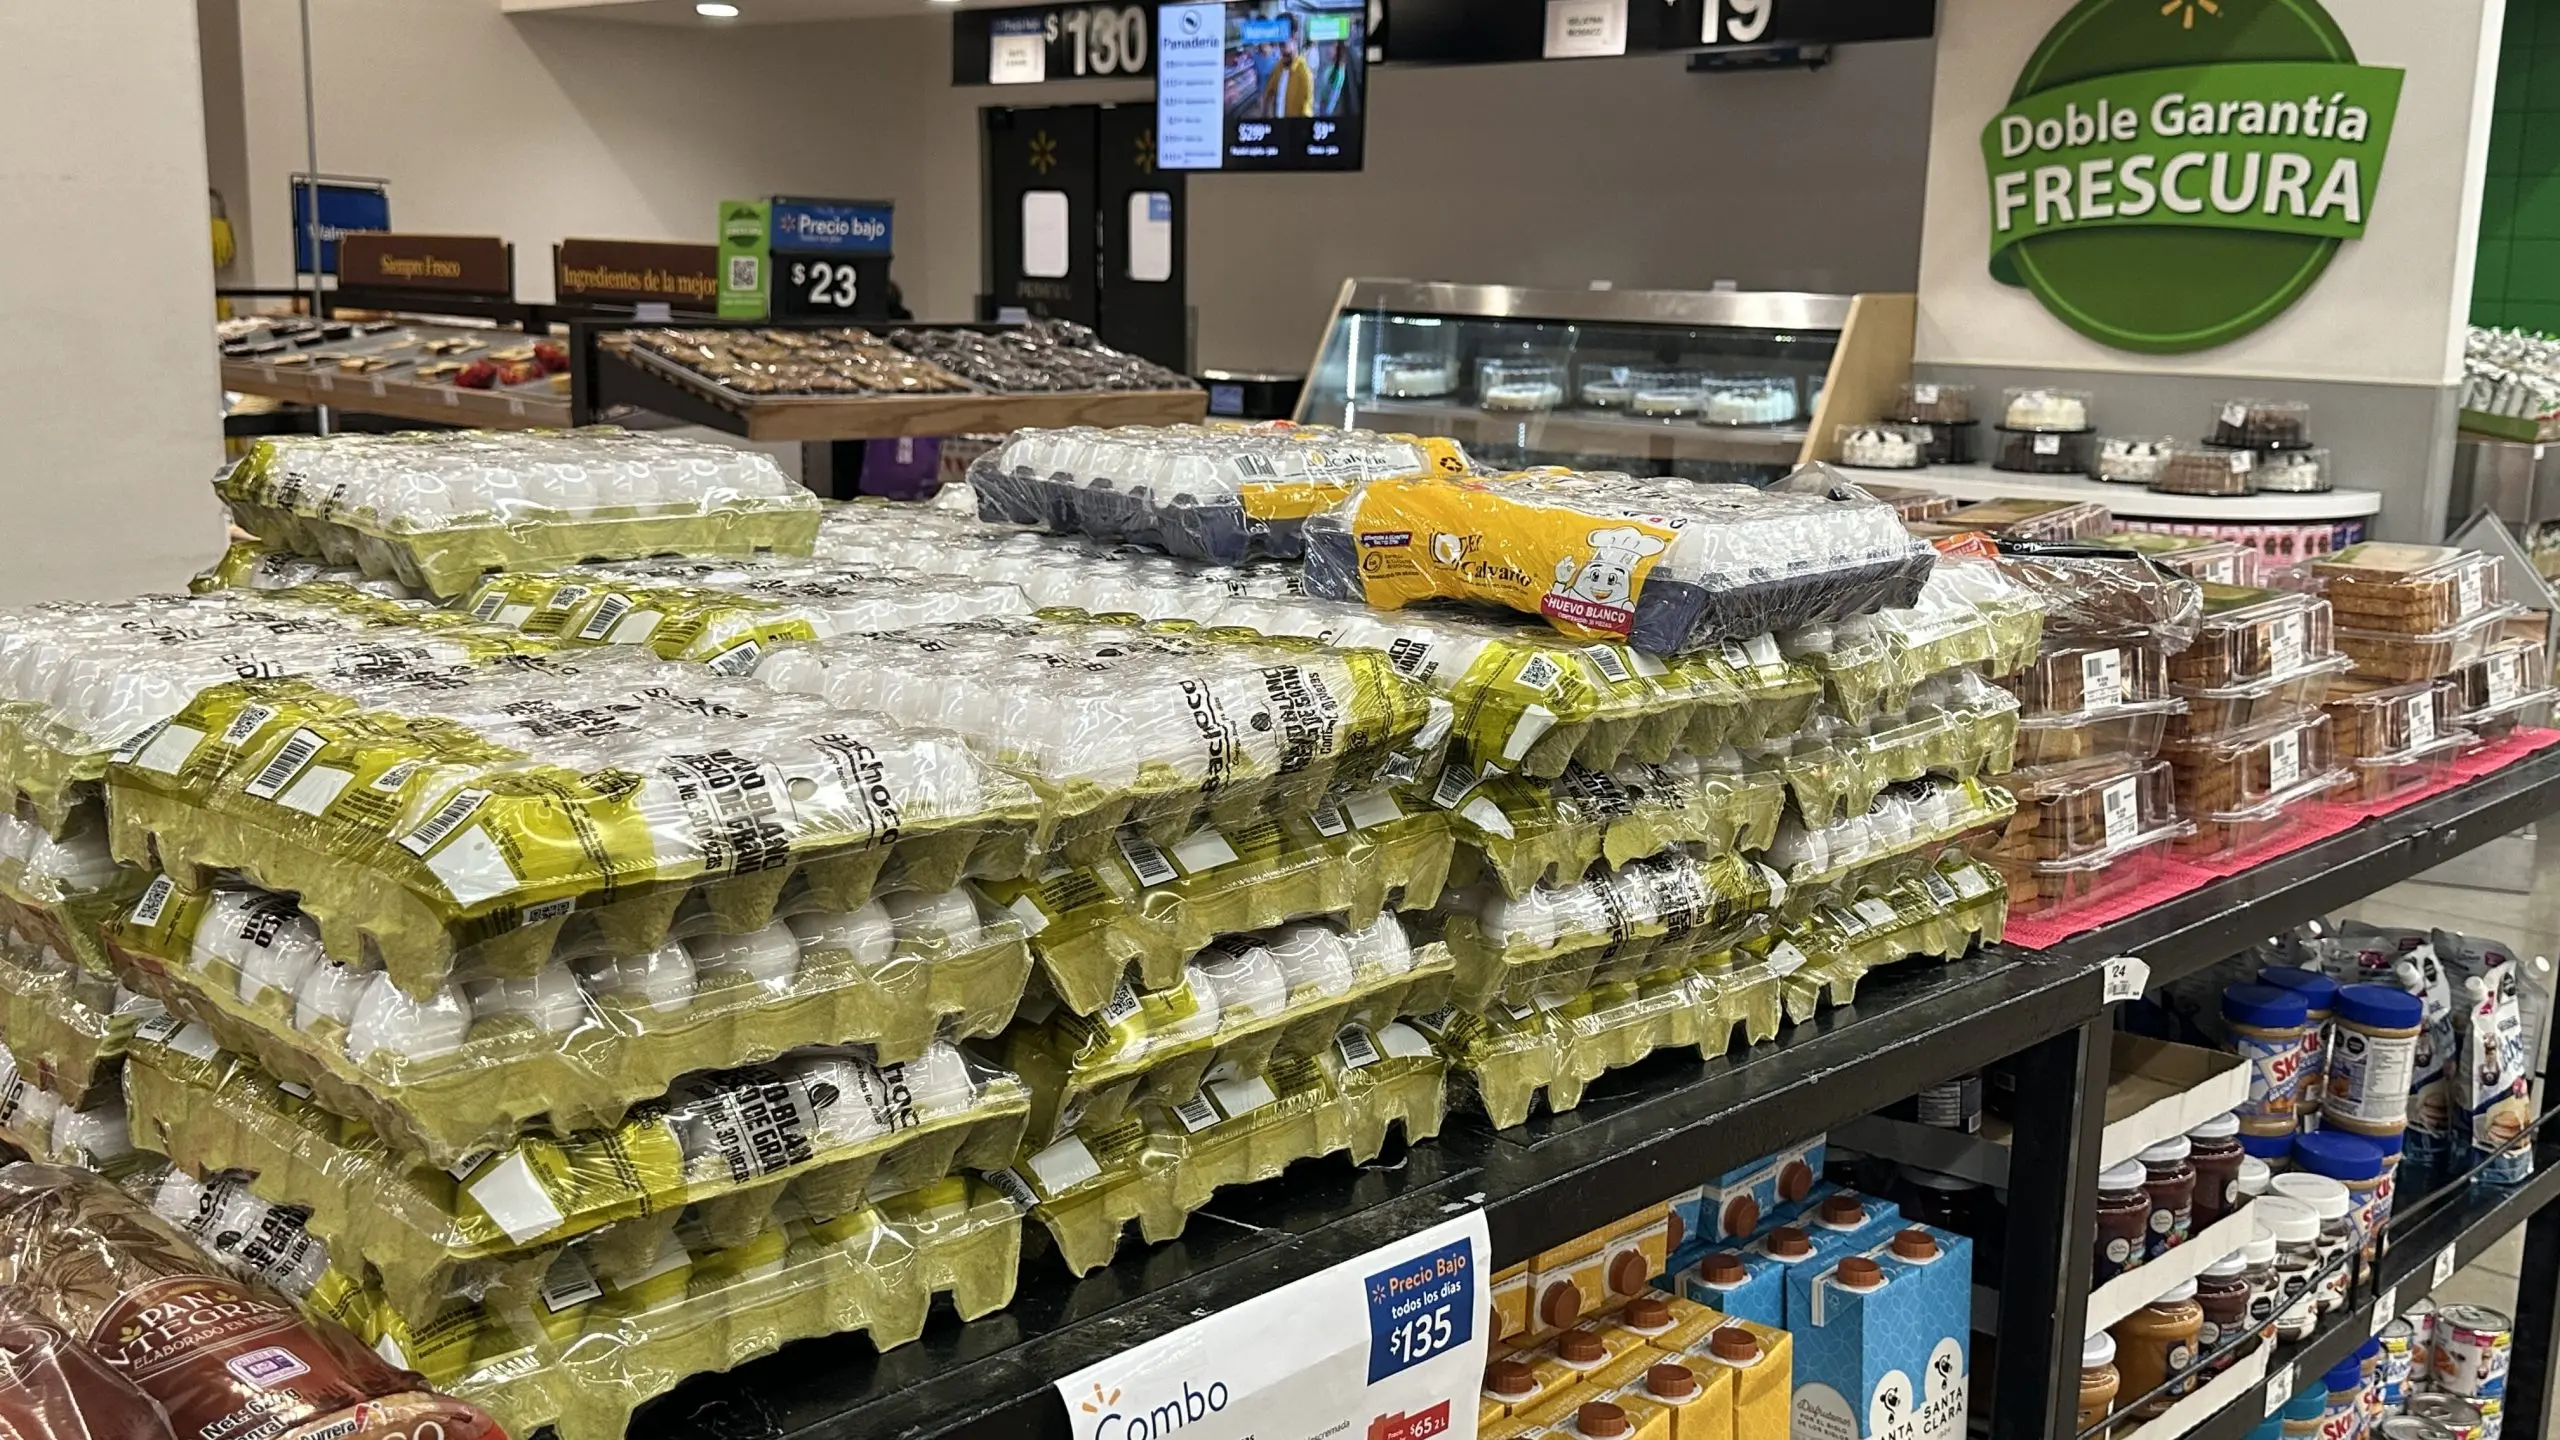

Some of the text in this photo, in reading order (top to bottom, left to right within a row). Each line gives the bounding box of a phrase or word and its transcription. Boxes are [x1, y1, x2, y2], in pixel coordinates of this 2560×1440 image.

[2000, 91, 2368, 158] Doble Garantía
[1995, 151, 2361, 231] FRESCURA
[799, 213, 886, 241] Precio bajo
[379, 254, 461, 280] Siempre Fresco
[563, 265, 642, 294] Ingredientes
[643, 272, 660, 292] de
[662, 272, 675, 293] la
[677, 272, 718, 300] mejor
[1461, 561, 1532, 587] Calvario
[1548, 597, 1626, 624] HUEVO BLANCO
[1389, 1253, 1466, 1297] Precio Bajo
[138, 1291, 214, 1328] PAN
[1391, 1279, 1461, 1319] todos los días
[104, 1300, 292, 1366] NTEGRAL
[133, 1325, 225, 1370] ELABORADO
[1390, 1304, 1452, 1363] $135
[1095, 1381, 1228, 1440] Combo
[1923, 1386, 1963, 1420] SANTA
[1923, 1401, 1963, 1434] CLARA
[1409, 1416, 1433, 1438] $65
